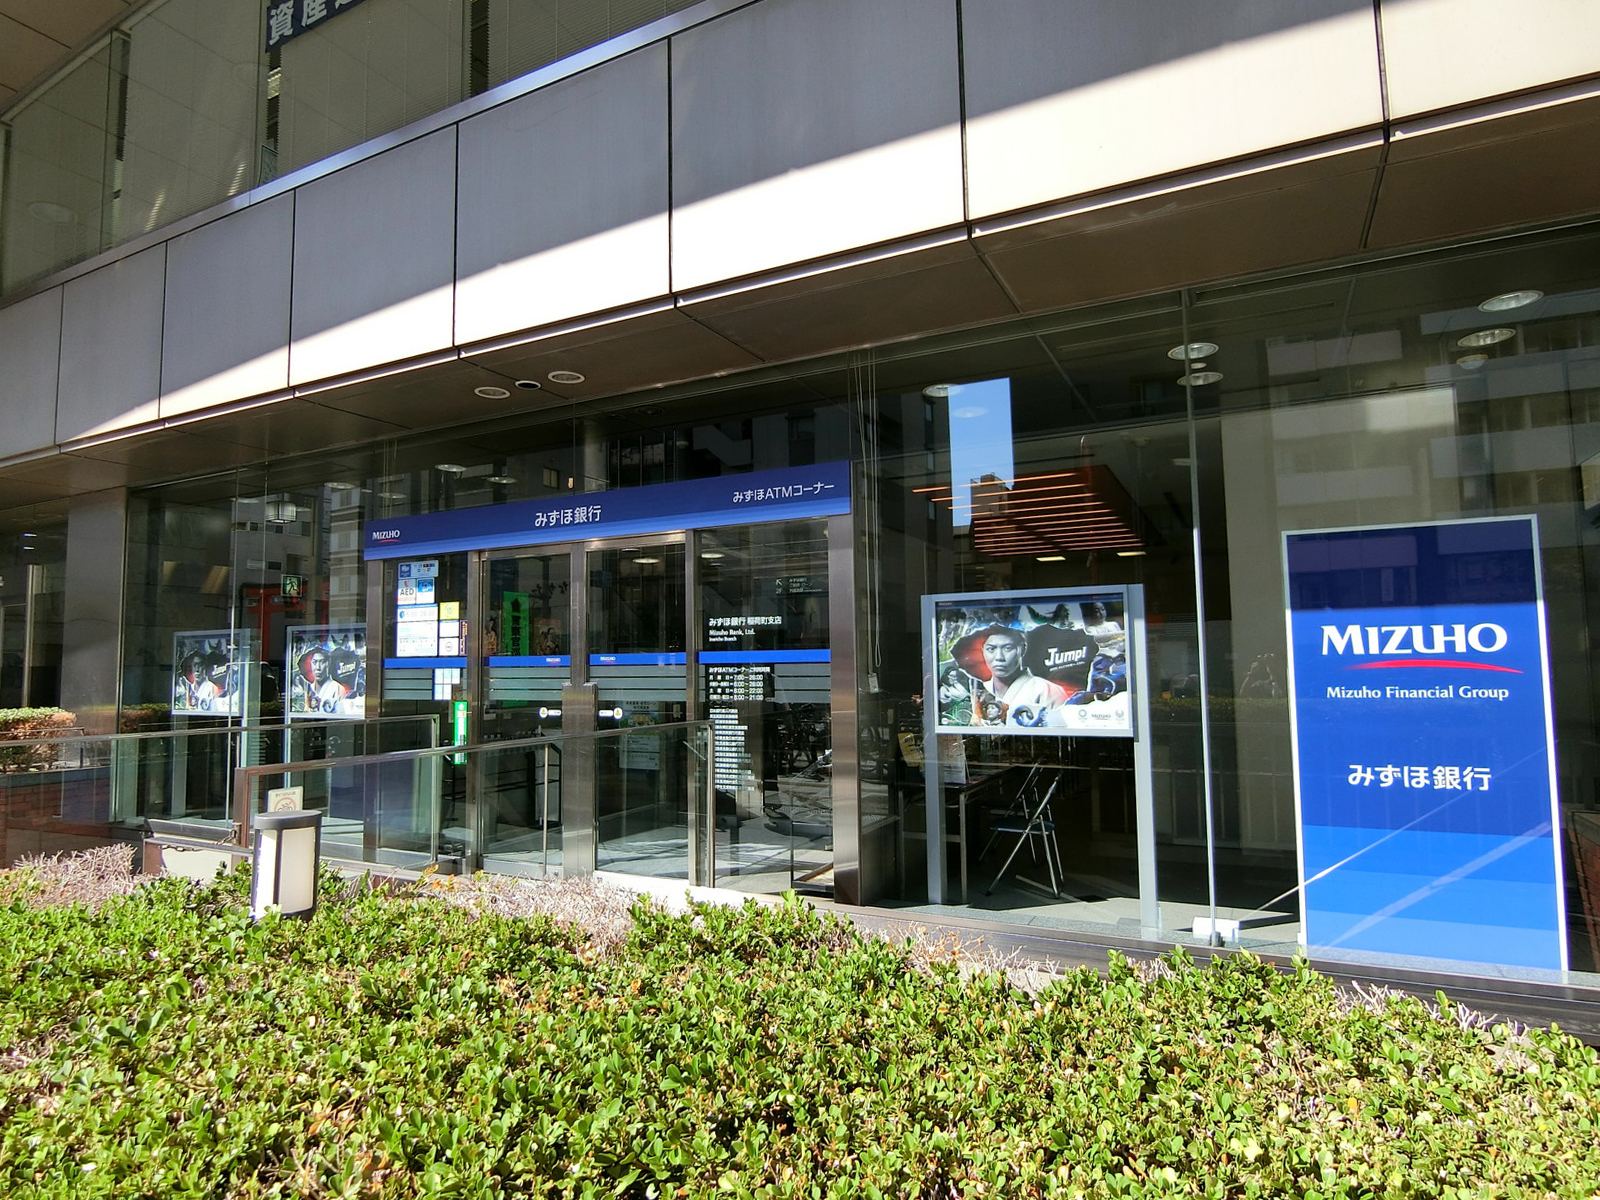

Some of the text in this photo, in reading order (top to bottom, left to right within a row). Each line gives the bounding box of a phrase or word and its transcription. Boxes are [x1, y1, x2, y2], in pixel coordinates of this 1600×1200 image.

[733, 481, 835, 503] みずほATMコーナー
[534, 505, 602, 527] みずほ銀行
[372, 529, 401, 540] MIZUHO
[400, 588, 414, 596] AED
[709, 617, 746, 626] みずほ銀行
[1321, 623, 1508, 656] MIZUHO
[1044, 646, 1087, 666] Jump!
[1327, 686, 1509, 701] Mizuho Financial Group
[1347, 764, 1492, 791] みずほ銀行
